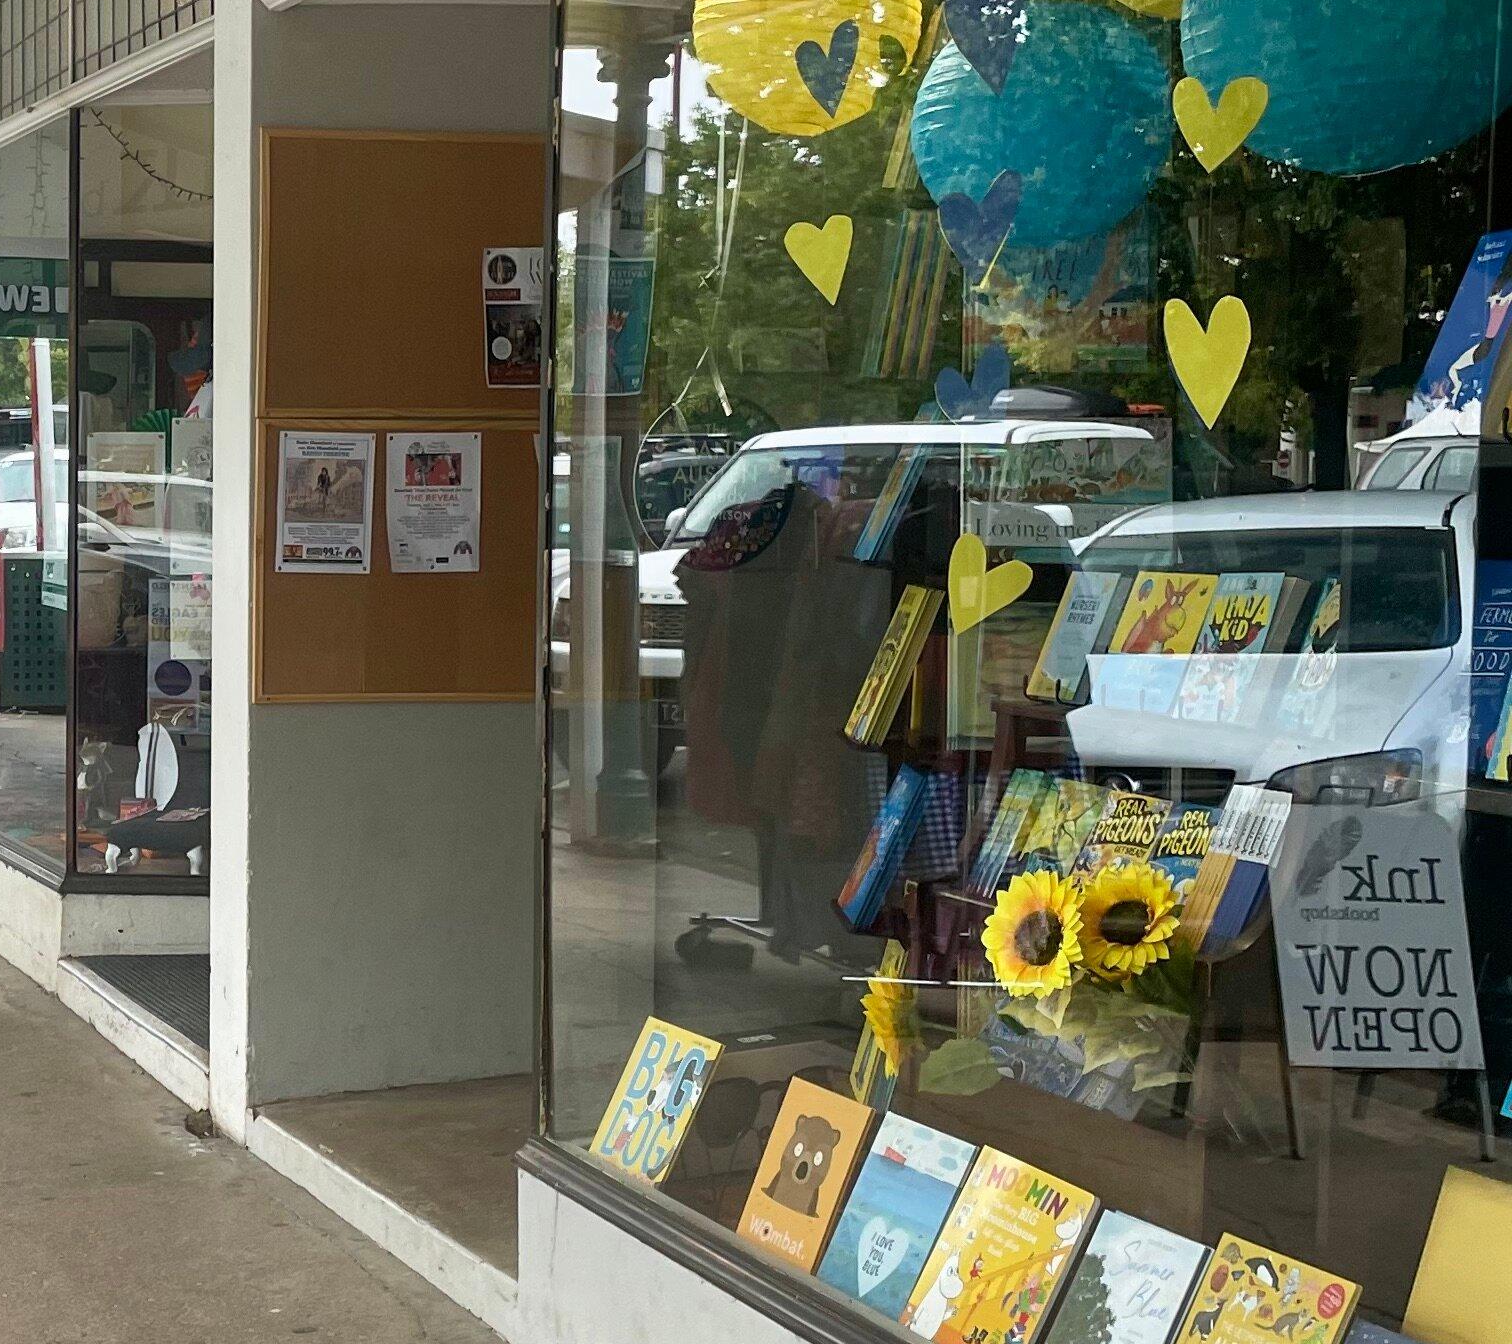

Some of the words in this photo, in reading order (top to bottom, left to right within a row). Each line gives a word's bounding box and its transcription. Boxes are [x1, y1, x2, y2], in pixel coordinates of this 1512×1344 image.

[975, 517, 1049, 539] Loving
[1114, 797, 1148, 818] REAL
[1180, 809, 1210, 829] REAL
[1094, 812, 1161, 844] PIGEONS
[1157, 828, 1215, 857] PIGEON
[626, 1031, 707, 1117] BIG
[600, 1098, 676, 1176] DOG
[986, 1163, 1070, 1221] MOOMIN
[875, 1234, 896, 1252] LOVE
